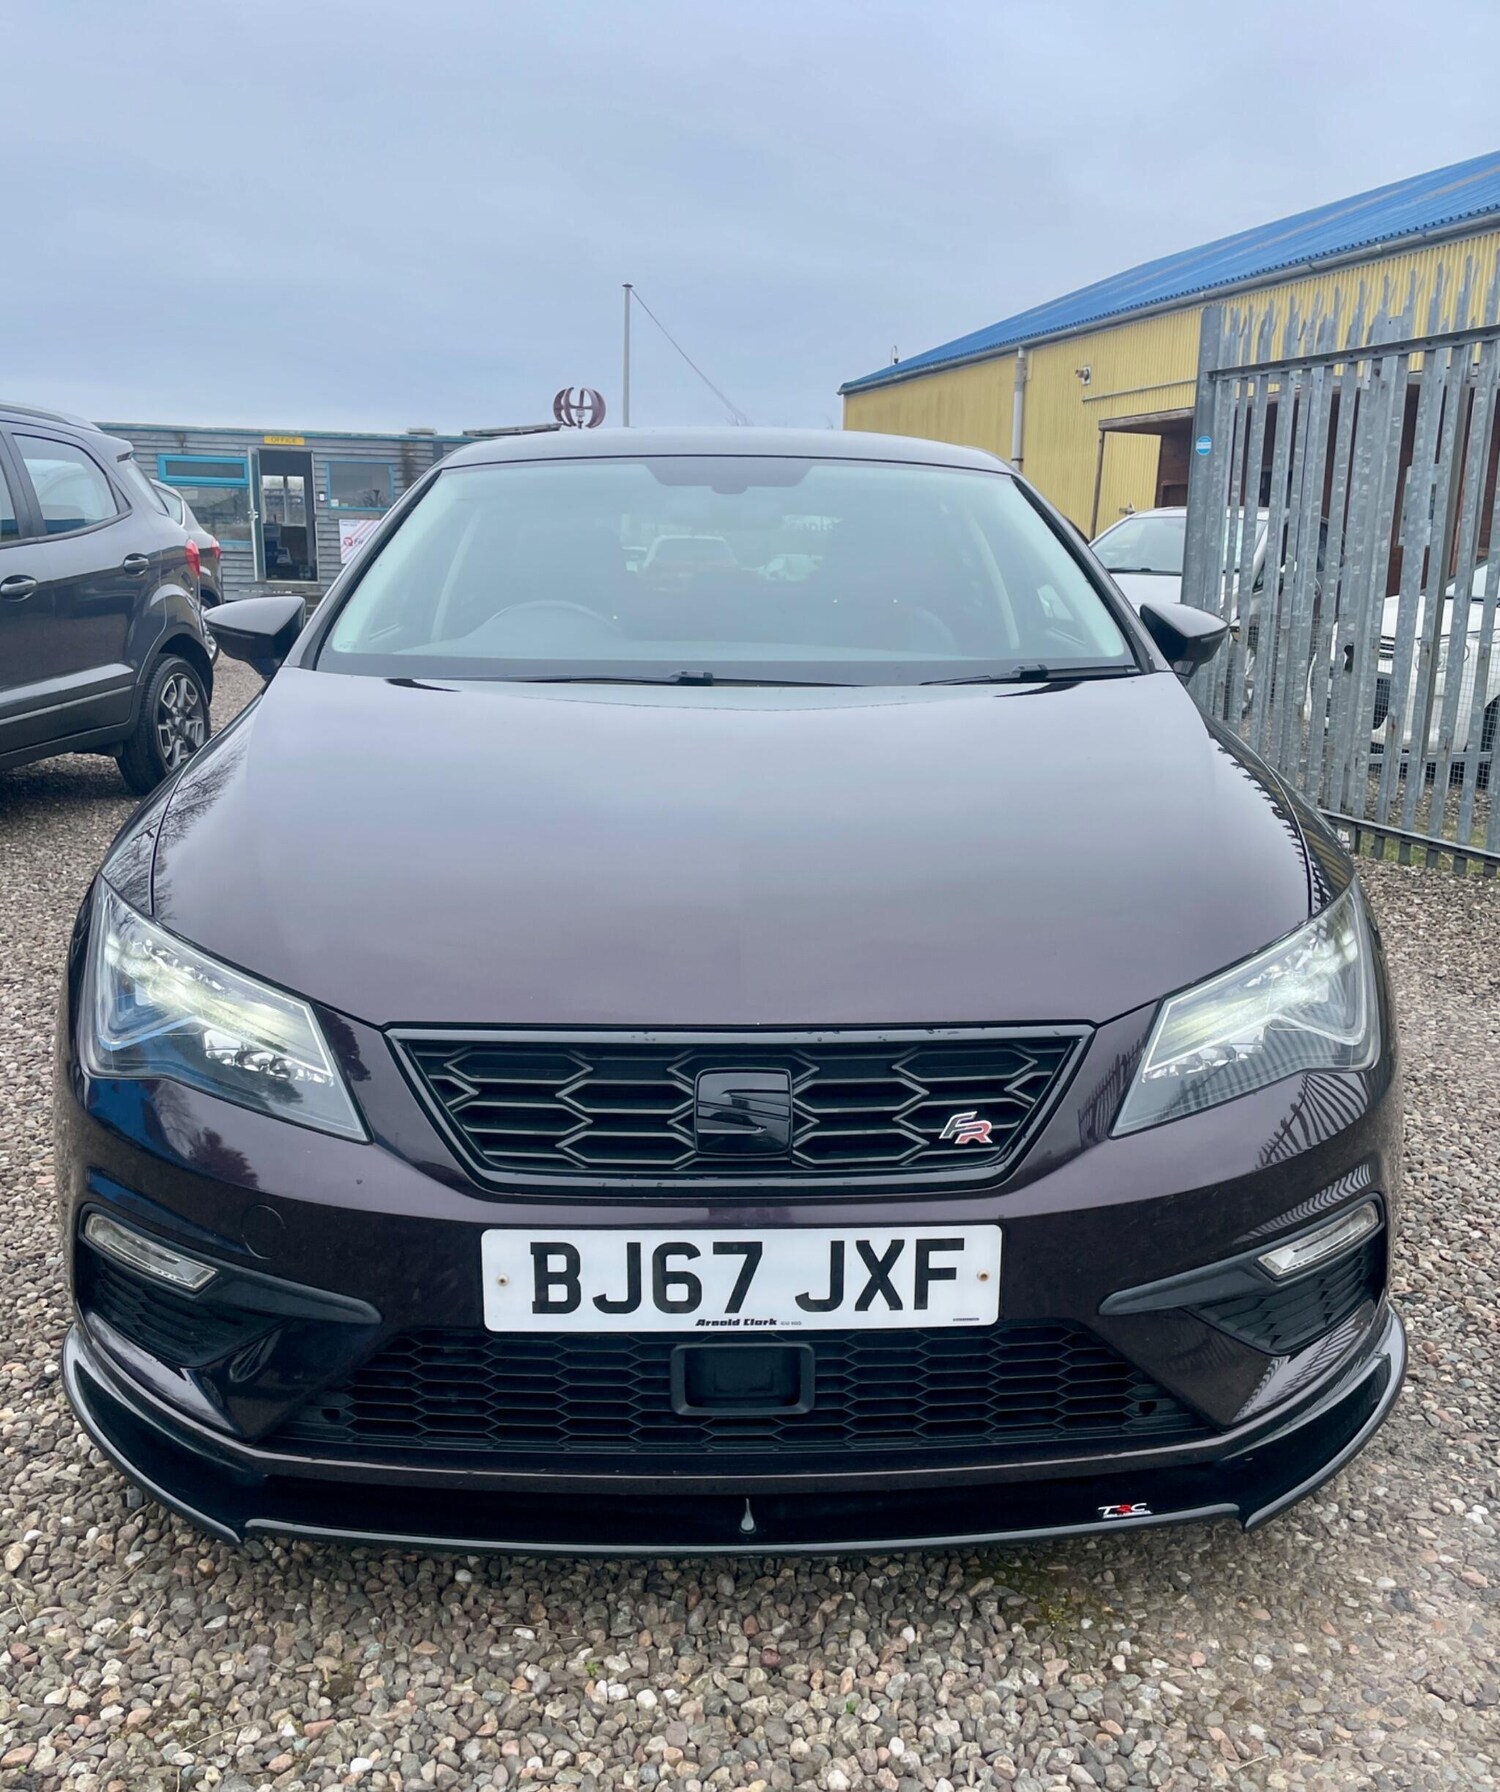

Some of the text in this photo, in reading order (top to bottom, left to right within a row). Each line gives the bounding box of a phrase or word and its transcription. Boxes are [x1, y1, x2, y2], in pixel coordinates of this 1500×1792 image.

[939, 1111, 993, 1144] FR
[530, 1238, 965, 1315] BJ67 JXF
[695, 1318, 741, 1327] Arnold
[743, 1318, 777, 1326] Clark
